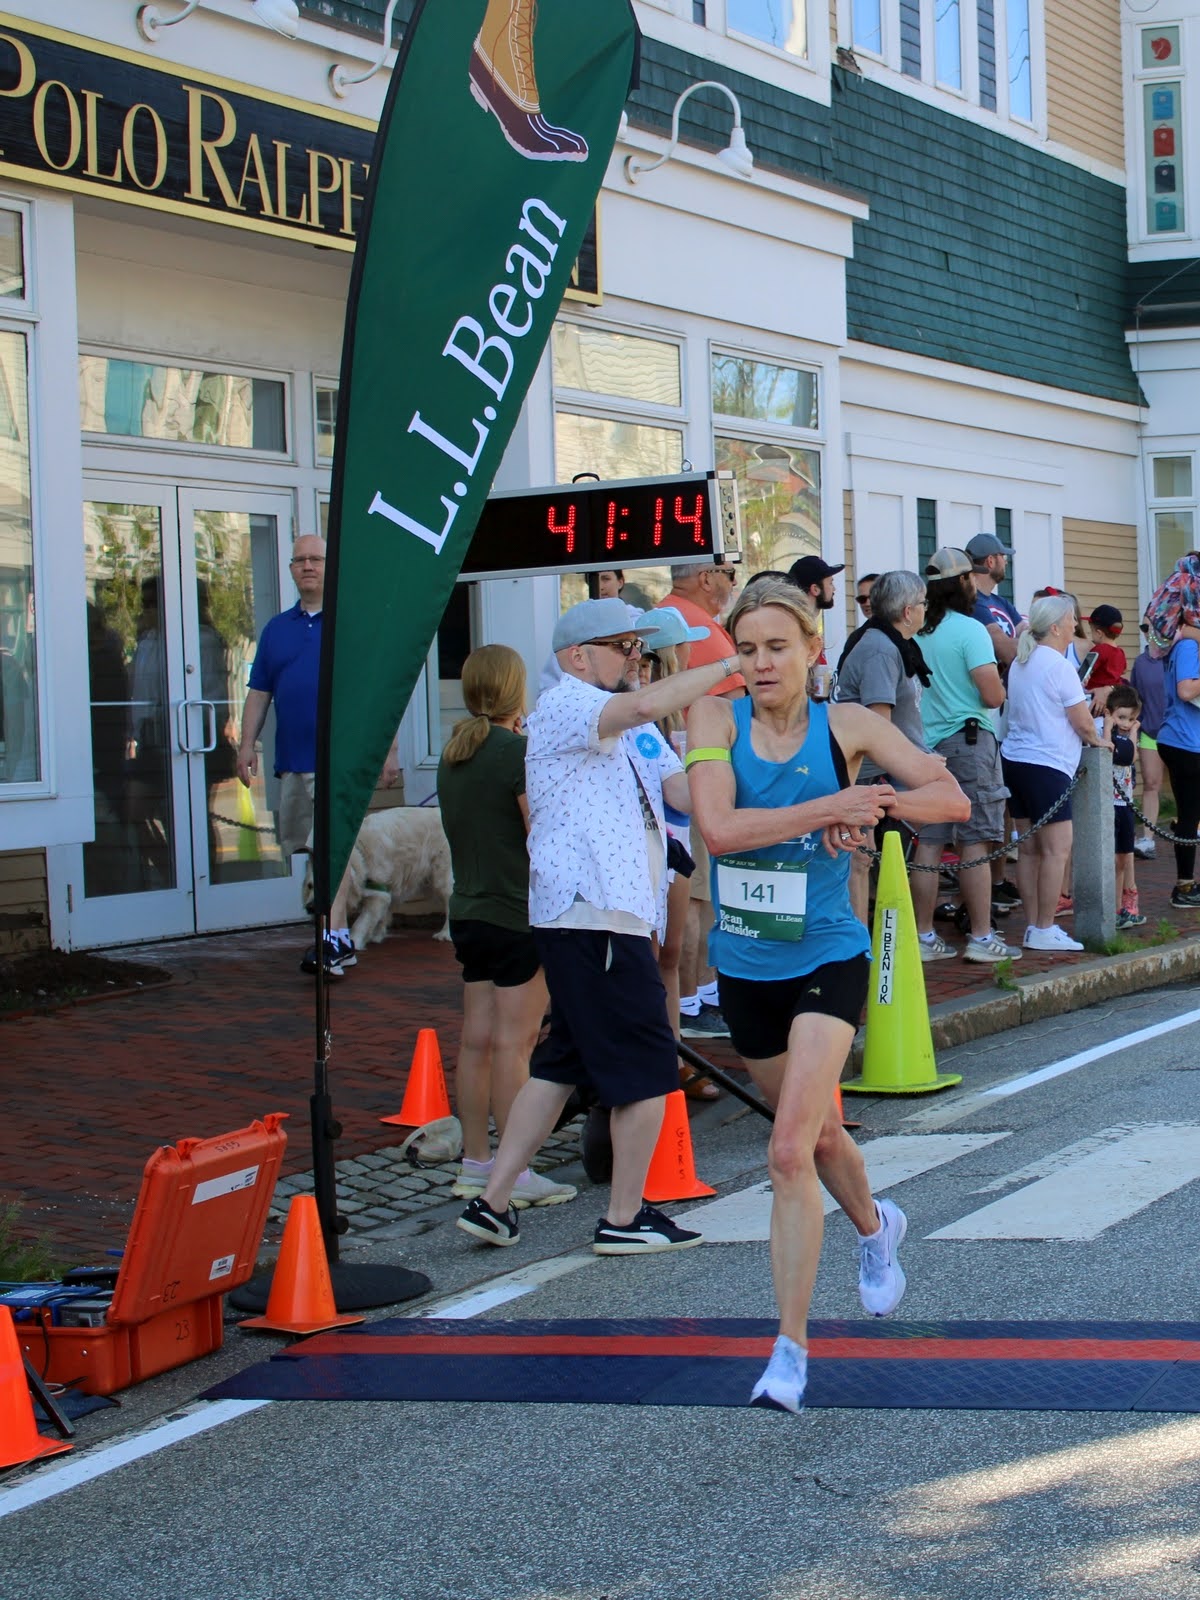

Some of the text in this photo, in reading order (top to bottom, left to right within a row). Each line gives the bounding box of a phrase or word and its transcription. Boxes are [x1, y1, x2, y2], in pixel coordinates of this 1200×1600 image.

[0, 33, 168, 190] POLO
[367, 197, 567, 556] L.L.Bean
[741, 882, 775, 903] 141
[720, 919, 760, 939] Outsider
[775, 914, 803, 923] L.L.Bean
[882, 932, 892, 971] BEAN
[879, 975, 888, 1004] 10K
[675, 1126, 686, 1180] GSRS
[175, 1319, 191, 1342] 23
